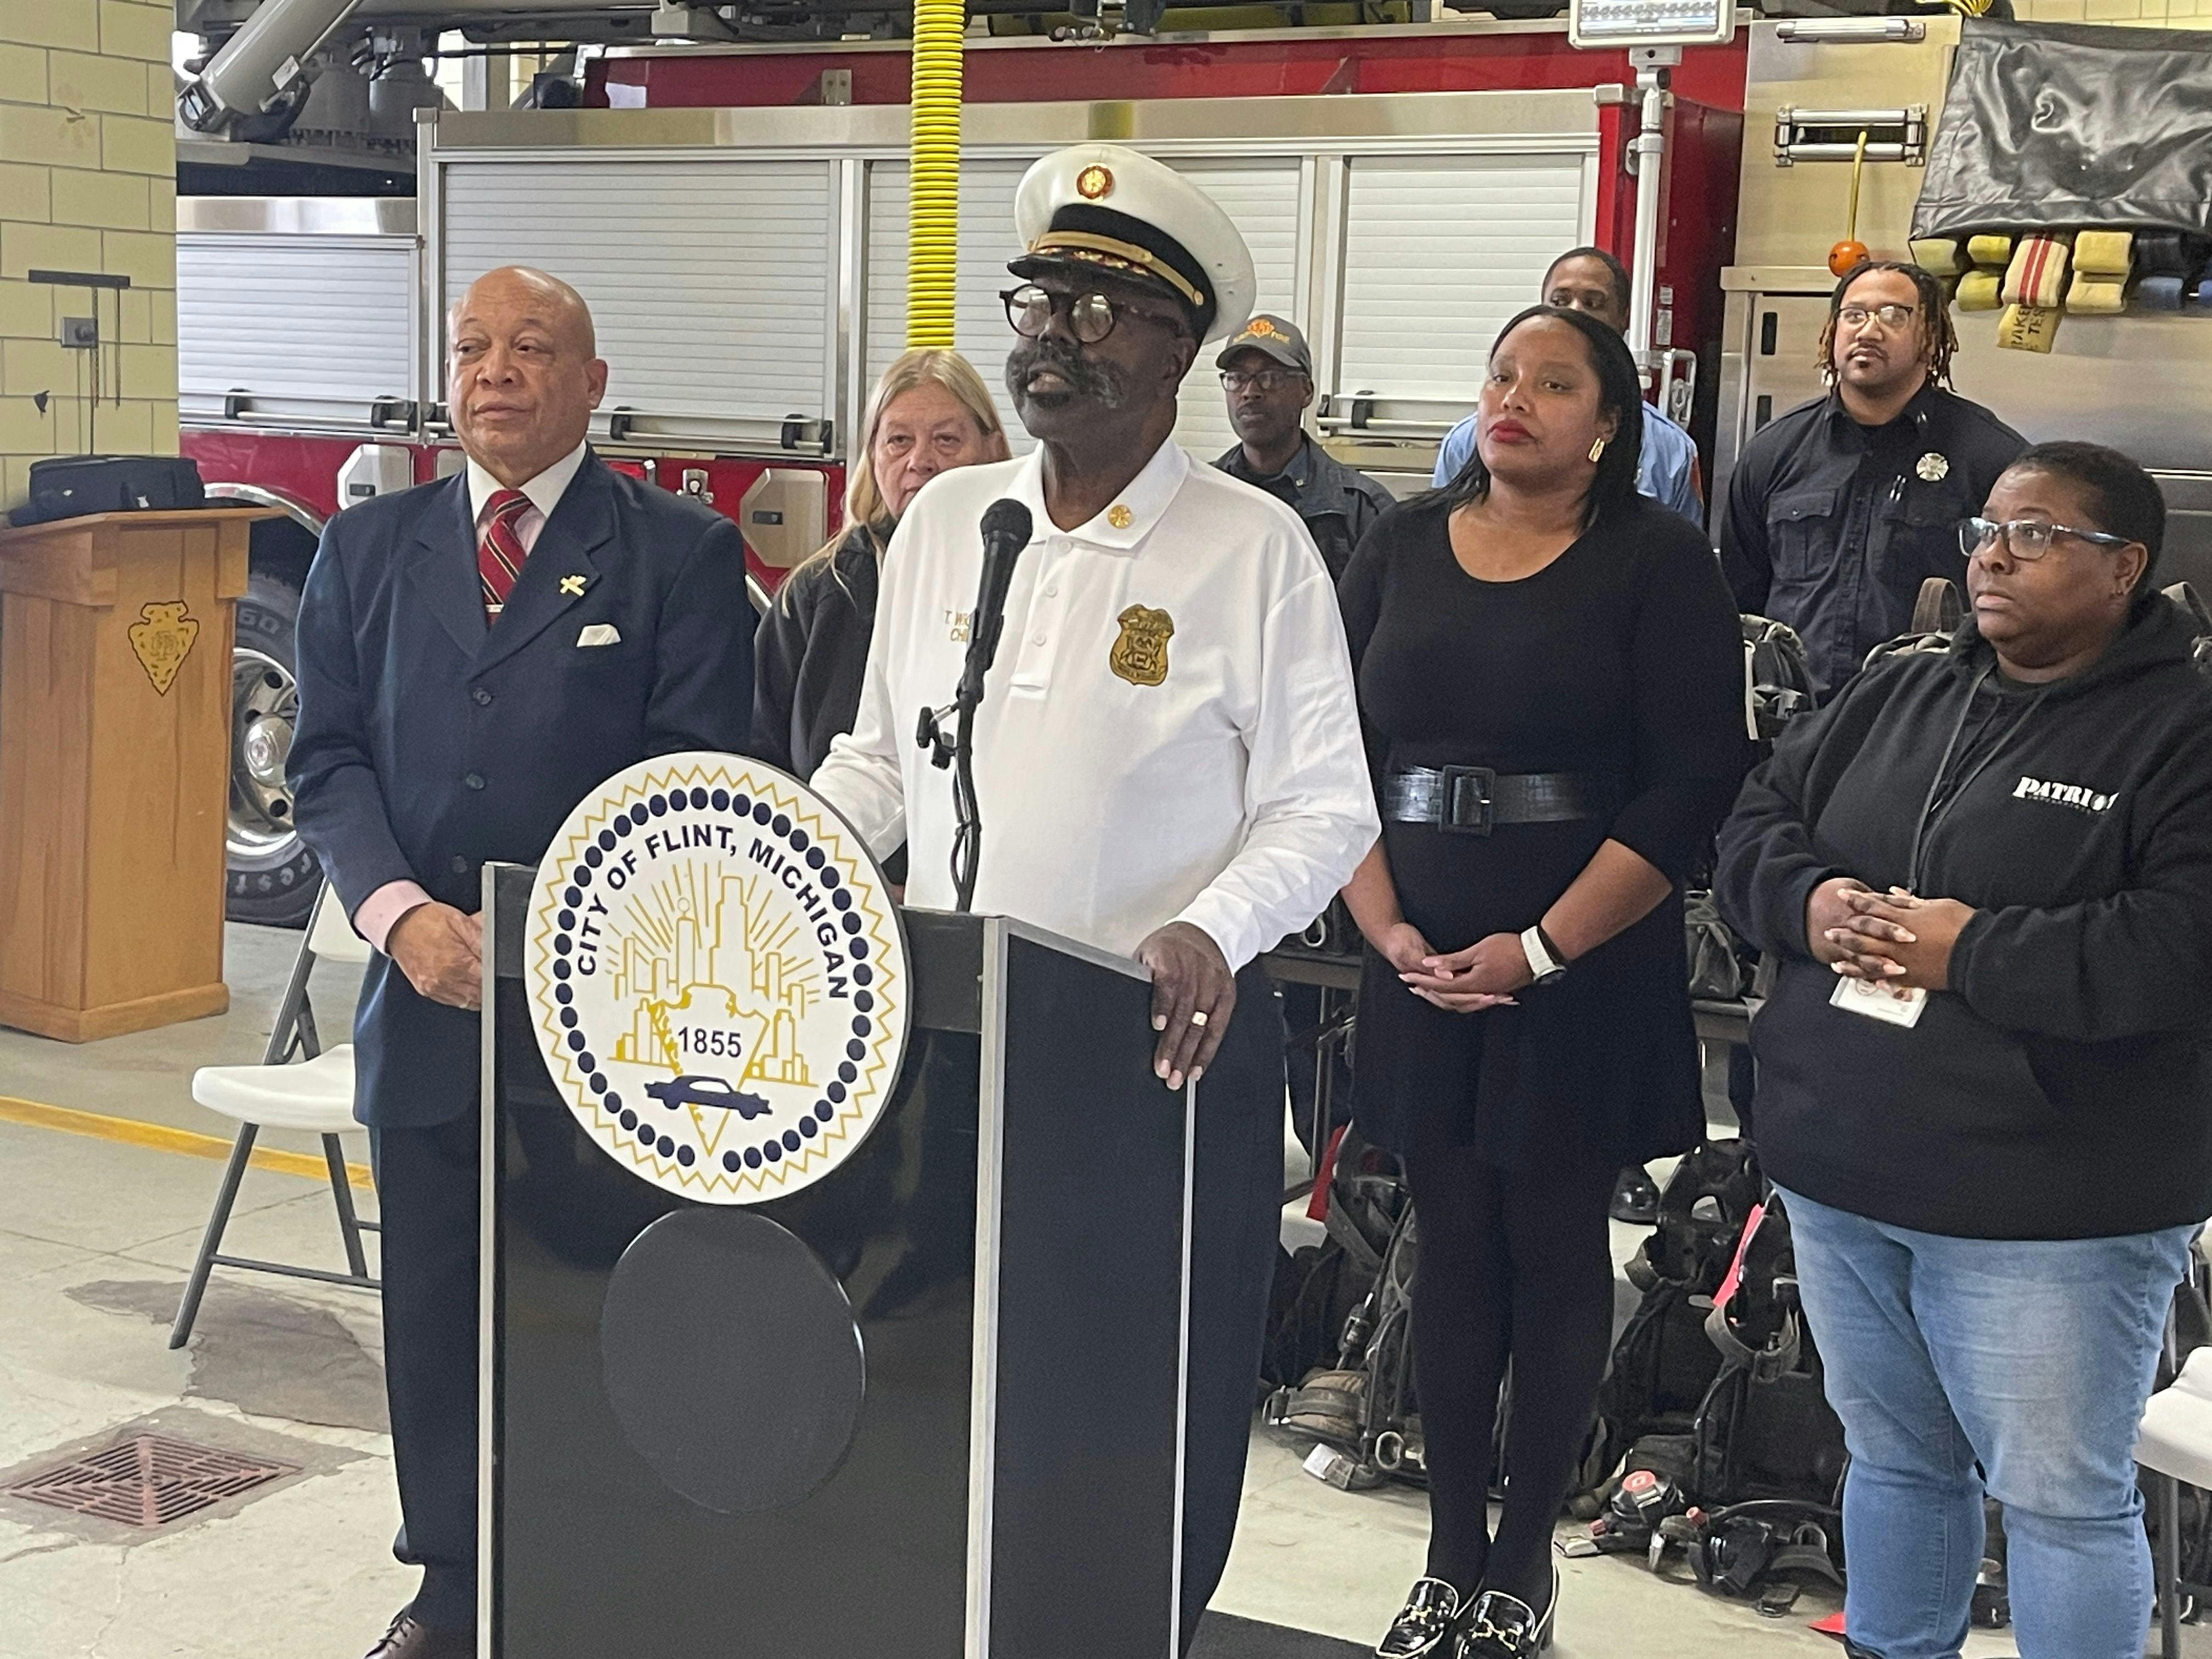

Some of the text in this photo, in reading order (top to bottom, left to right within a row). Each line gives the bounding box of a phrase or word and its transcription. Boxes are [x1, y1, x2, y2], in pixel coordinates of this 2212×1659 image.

[578, 824, 849, 998] CITY OF FLINT, MICHIGAN
[678, 1026, 742, 1058] 1855
